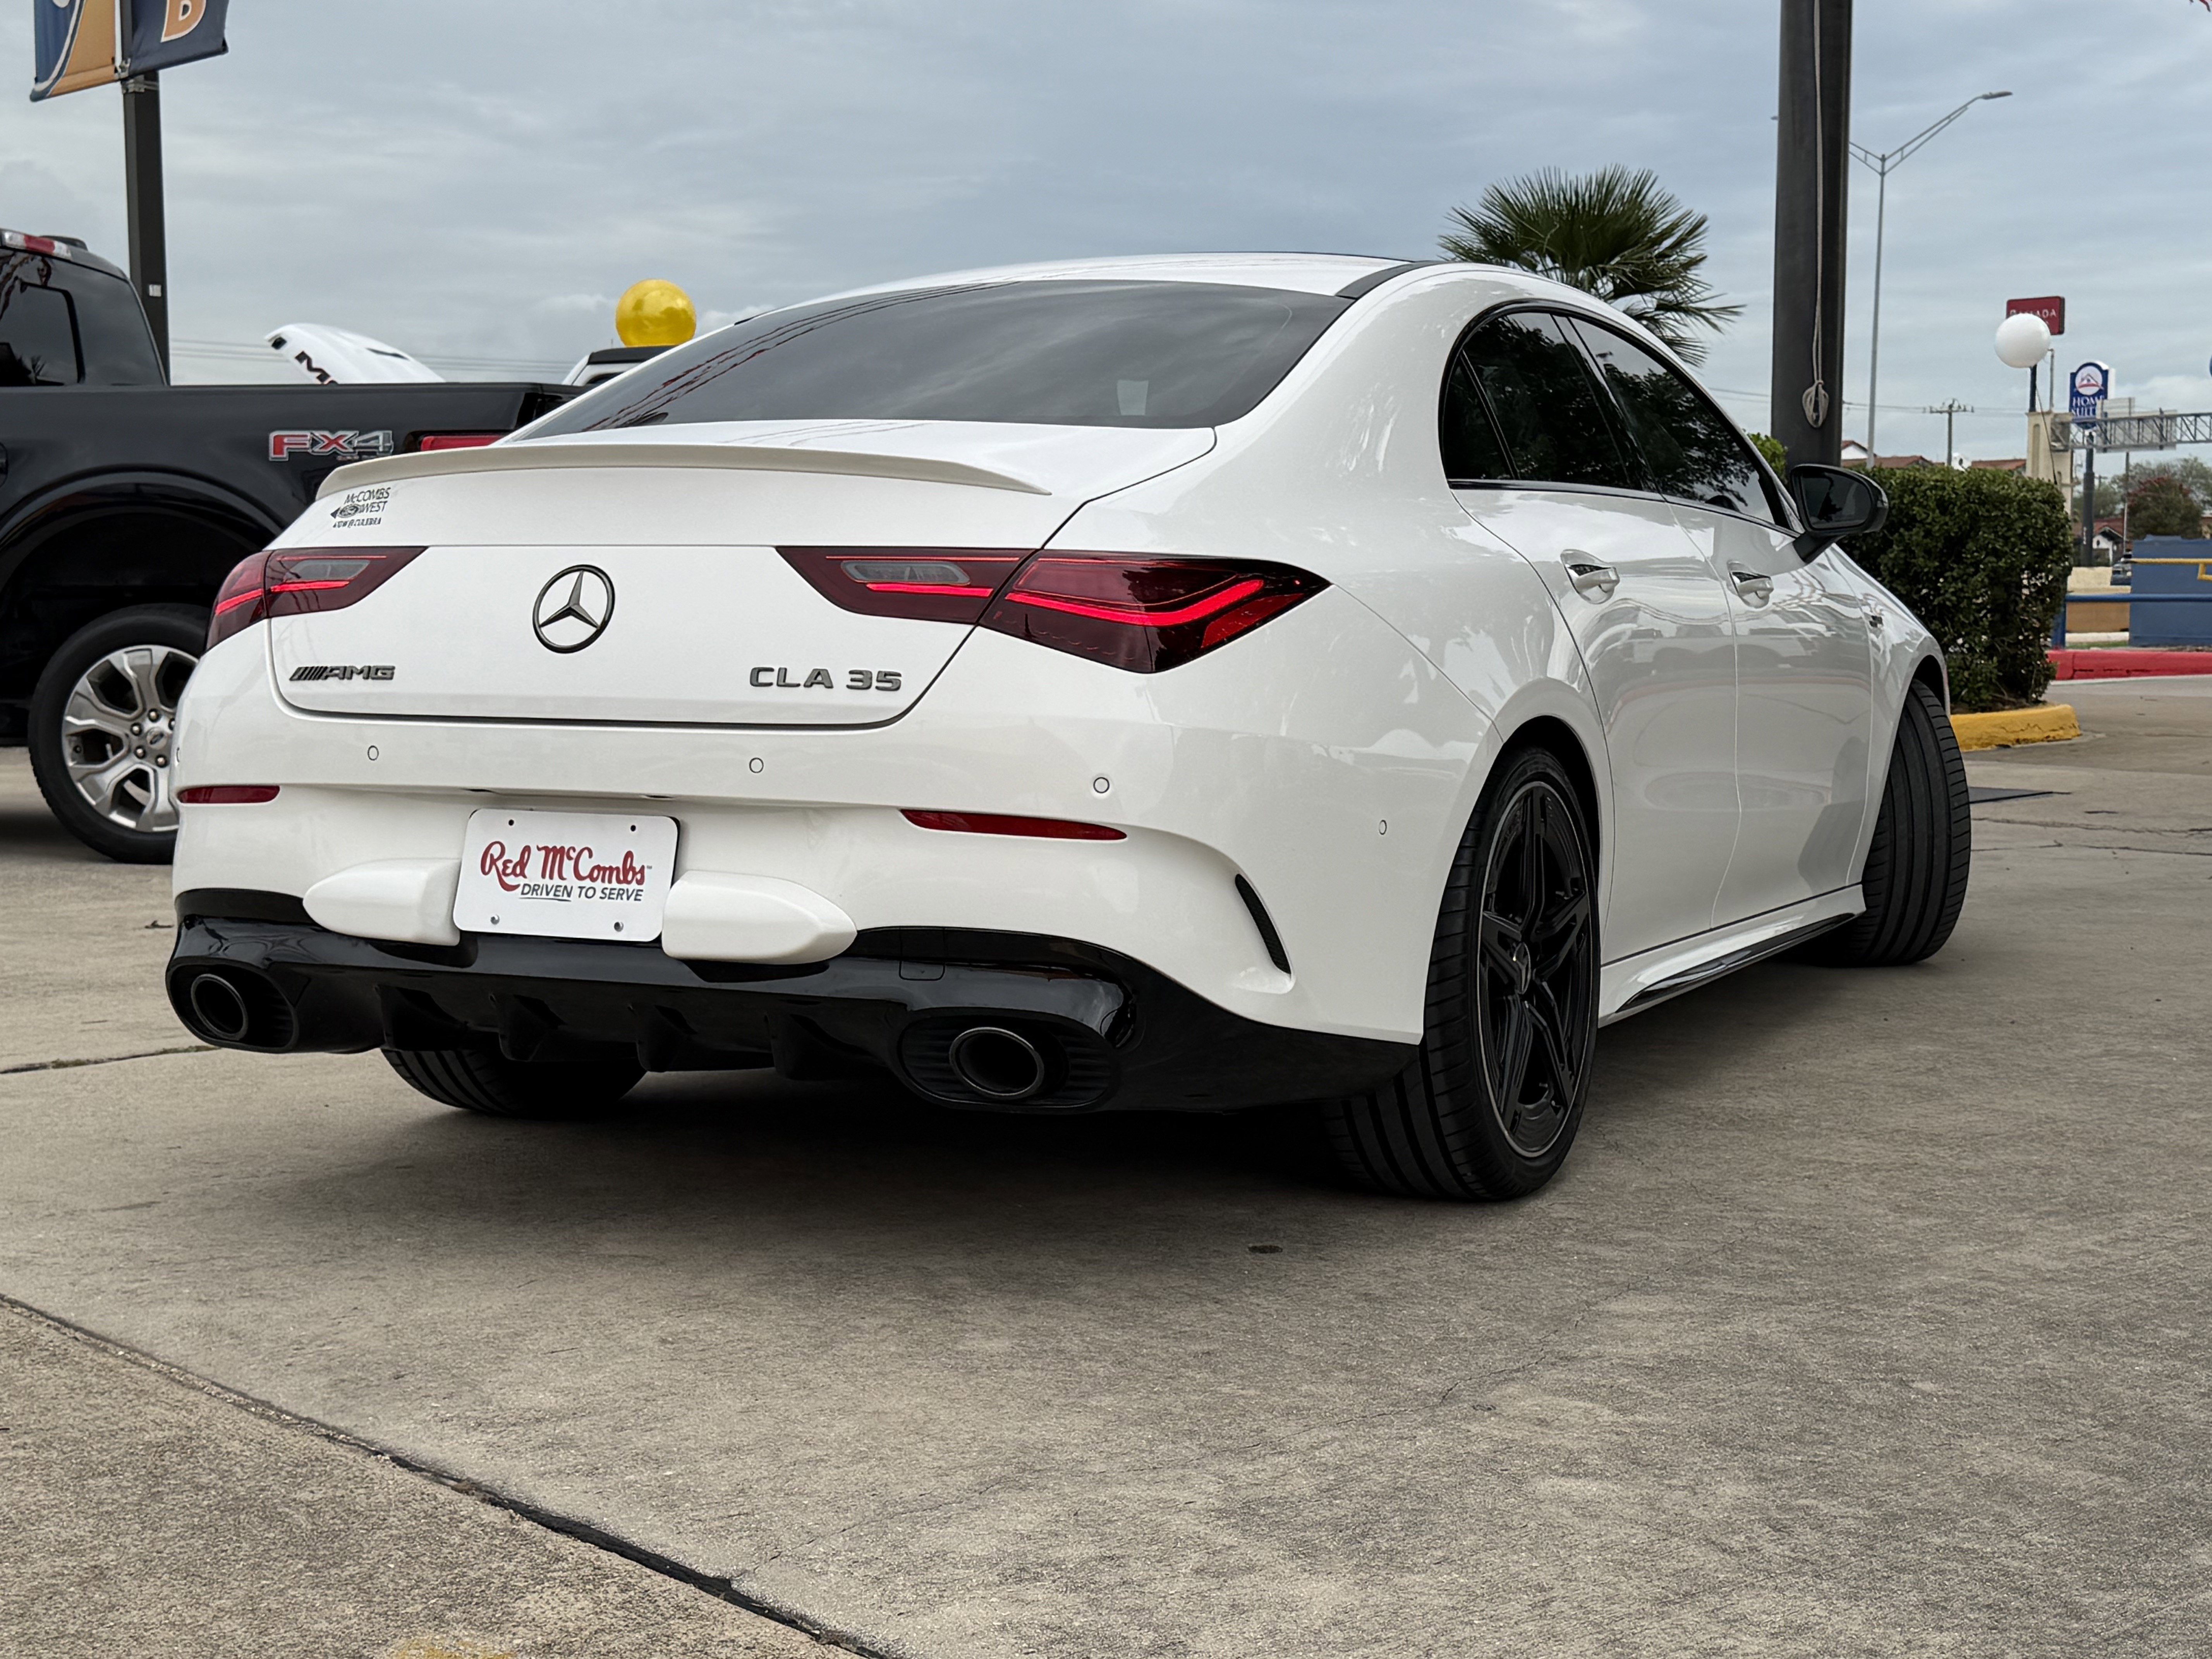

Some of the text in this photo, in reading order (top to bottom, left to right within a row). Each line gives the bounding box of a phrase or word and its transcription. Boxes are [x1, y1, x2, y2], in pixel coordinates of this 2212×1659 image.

[2073, 395, 2104, 407] HOM
[269, 430, 394, 461] FX4
[322, 665, 395, 680] AMG
[750, 667, 902, 691] CLA 35
[480, 841, 645, 891] Red McCombs
[520, 883, 644, 902] DRIVEN TO SERVE
